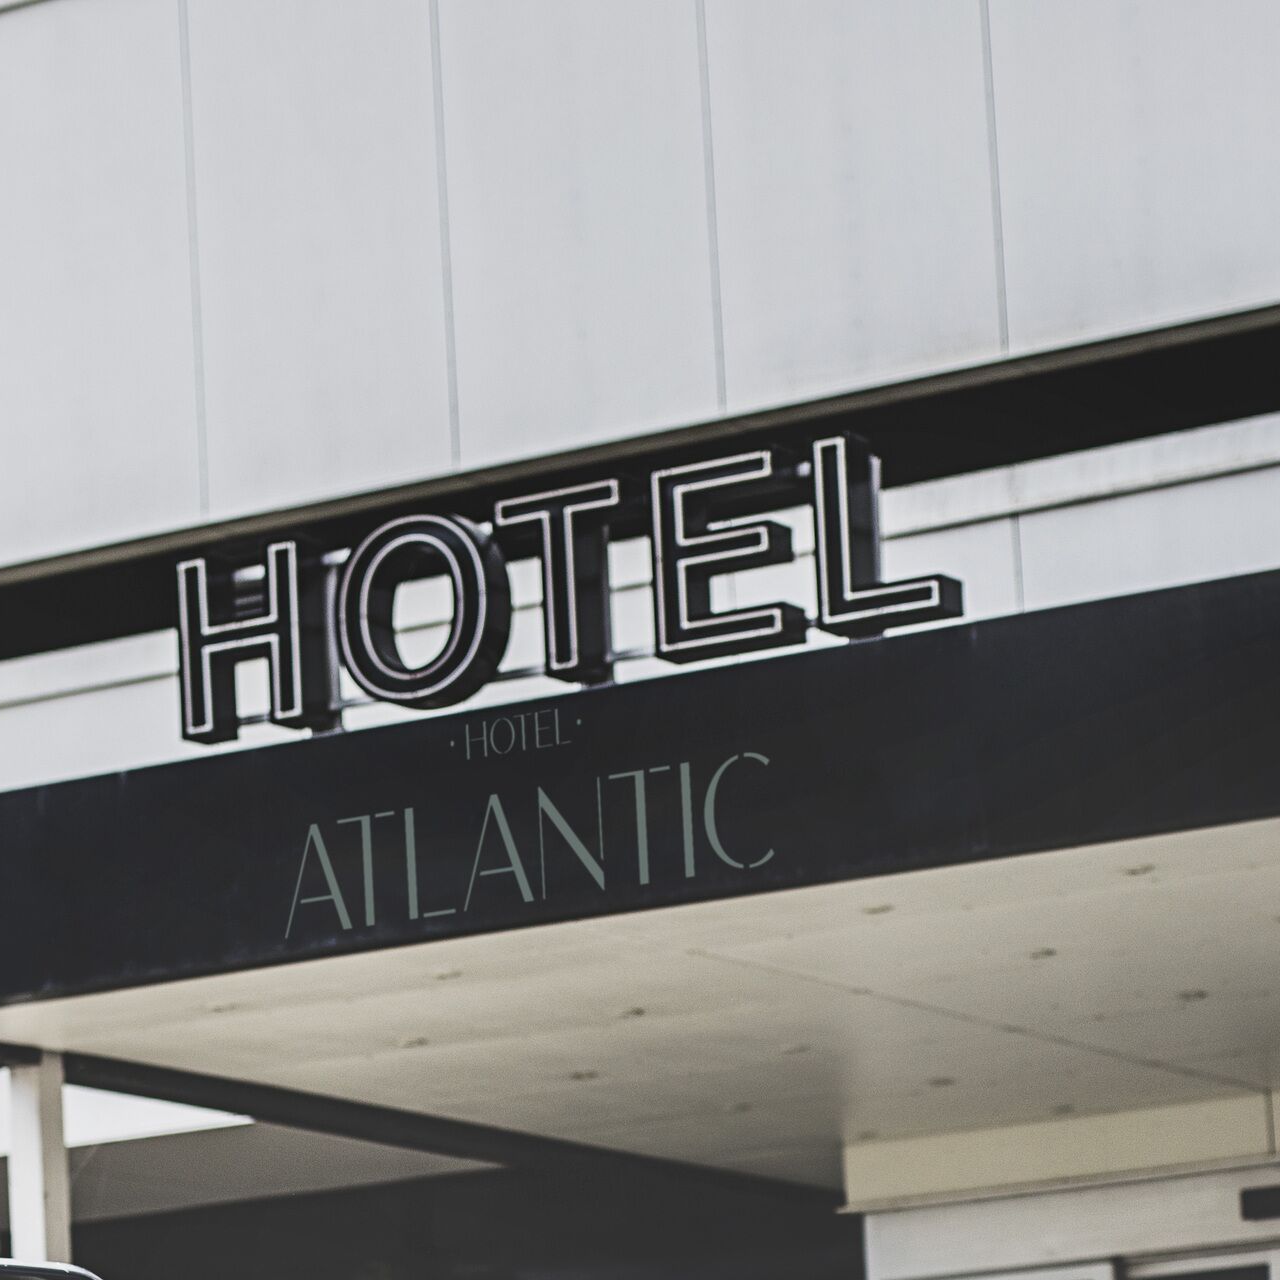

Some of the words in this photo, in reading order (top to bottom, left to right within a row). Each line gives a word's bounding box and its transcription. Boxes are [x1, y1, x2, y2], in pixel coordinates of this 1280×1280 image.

[176, 434, 962, 745] HOTEL
[464, 708, 572, 761] HOTEL
[283, 751, 776, 940] ATLANTIC
